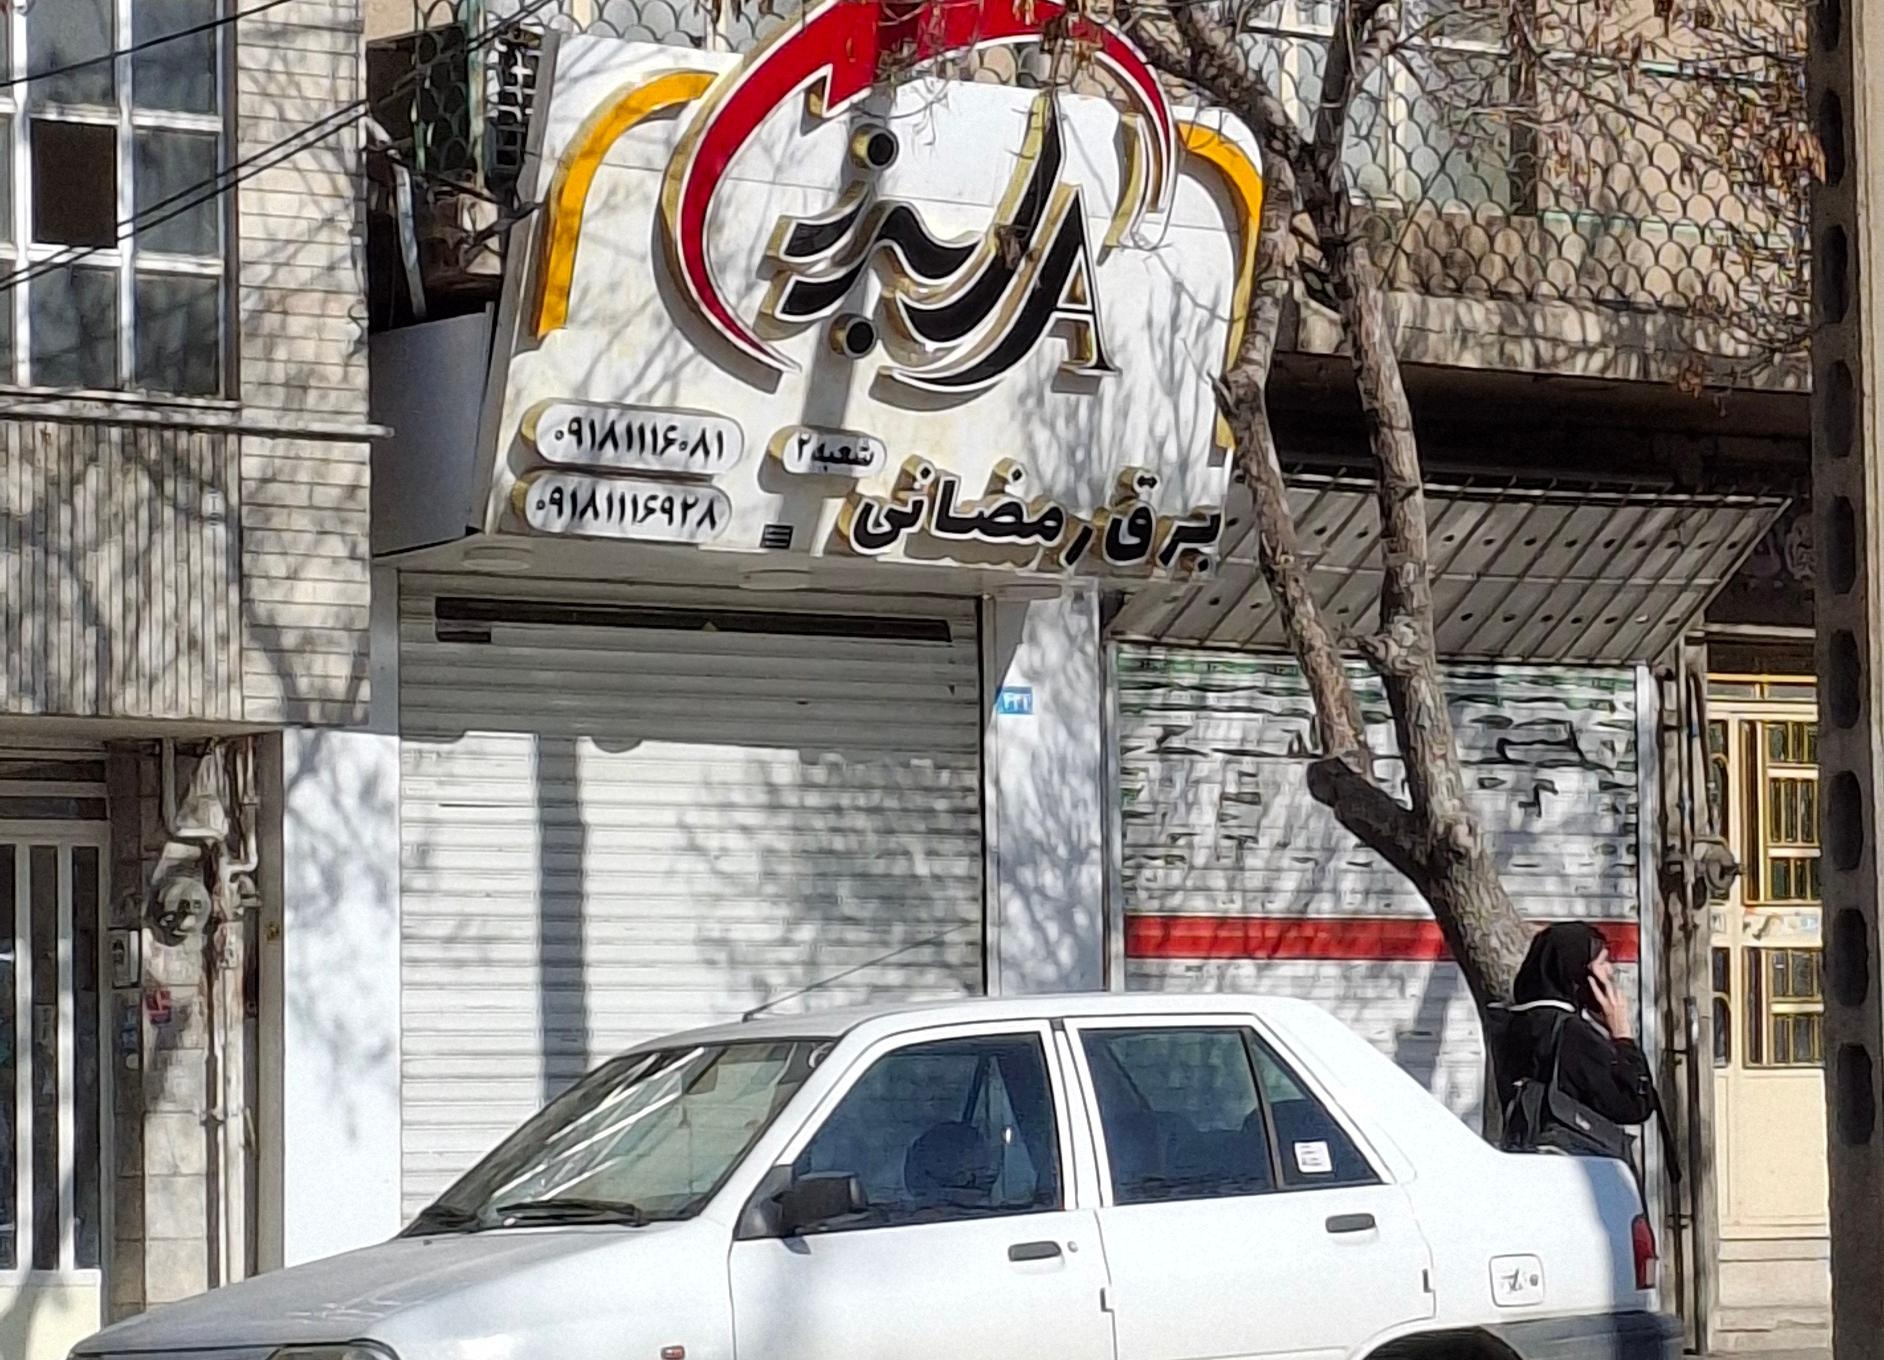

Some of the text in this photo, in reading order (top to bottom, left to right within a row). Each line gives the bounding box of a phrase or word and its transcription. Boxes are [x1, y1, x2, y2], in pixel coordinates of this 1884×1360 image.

[554, 415, 724, 461] ۰۹۱۸۱۱۱۶۰۸۱
[797, 433, 875, 473] شعبه ۲
[535, 485, 717, 531] ۰۹۱۸۱۱۱۶۹۲۸
[853, 466, 1223, 573] برق رمضانی
